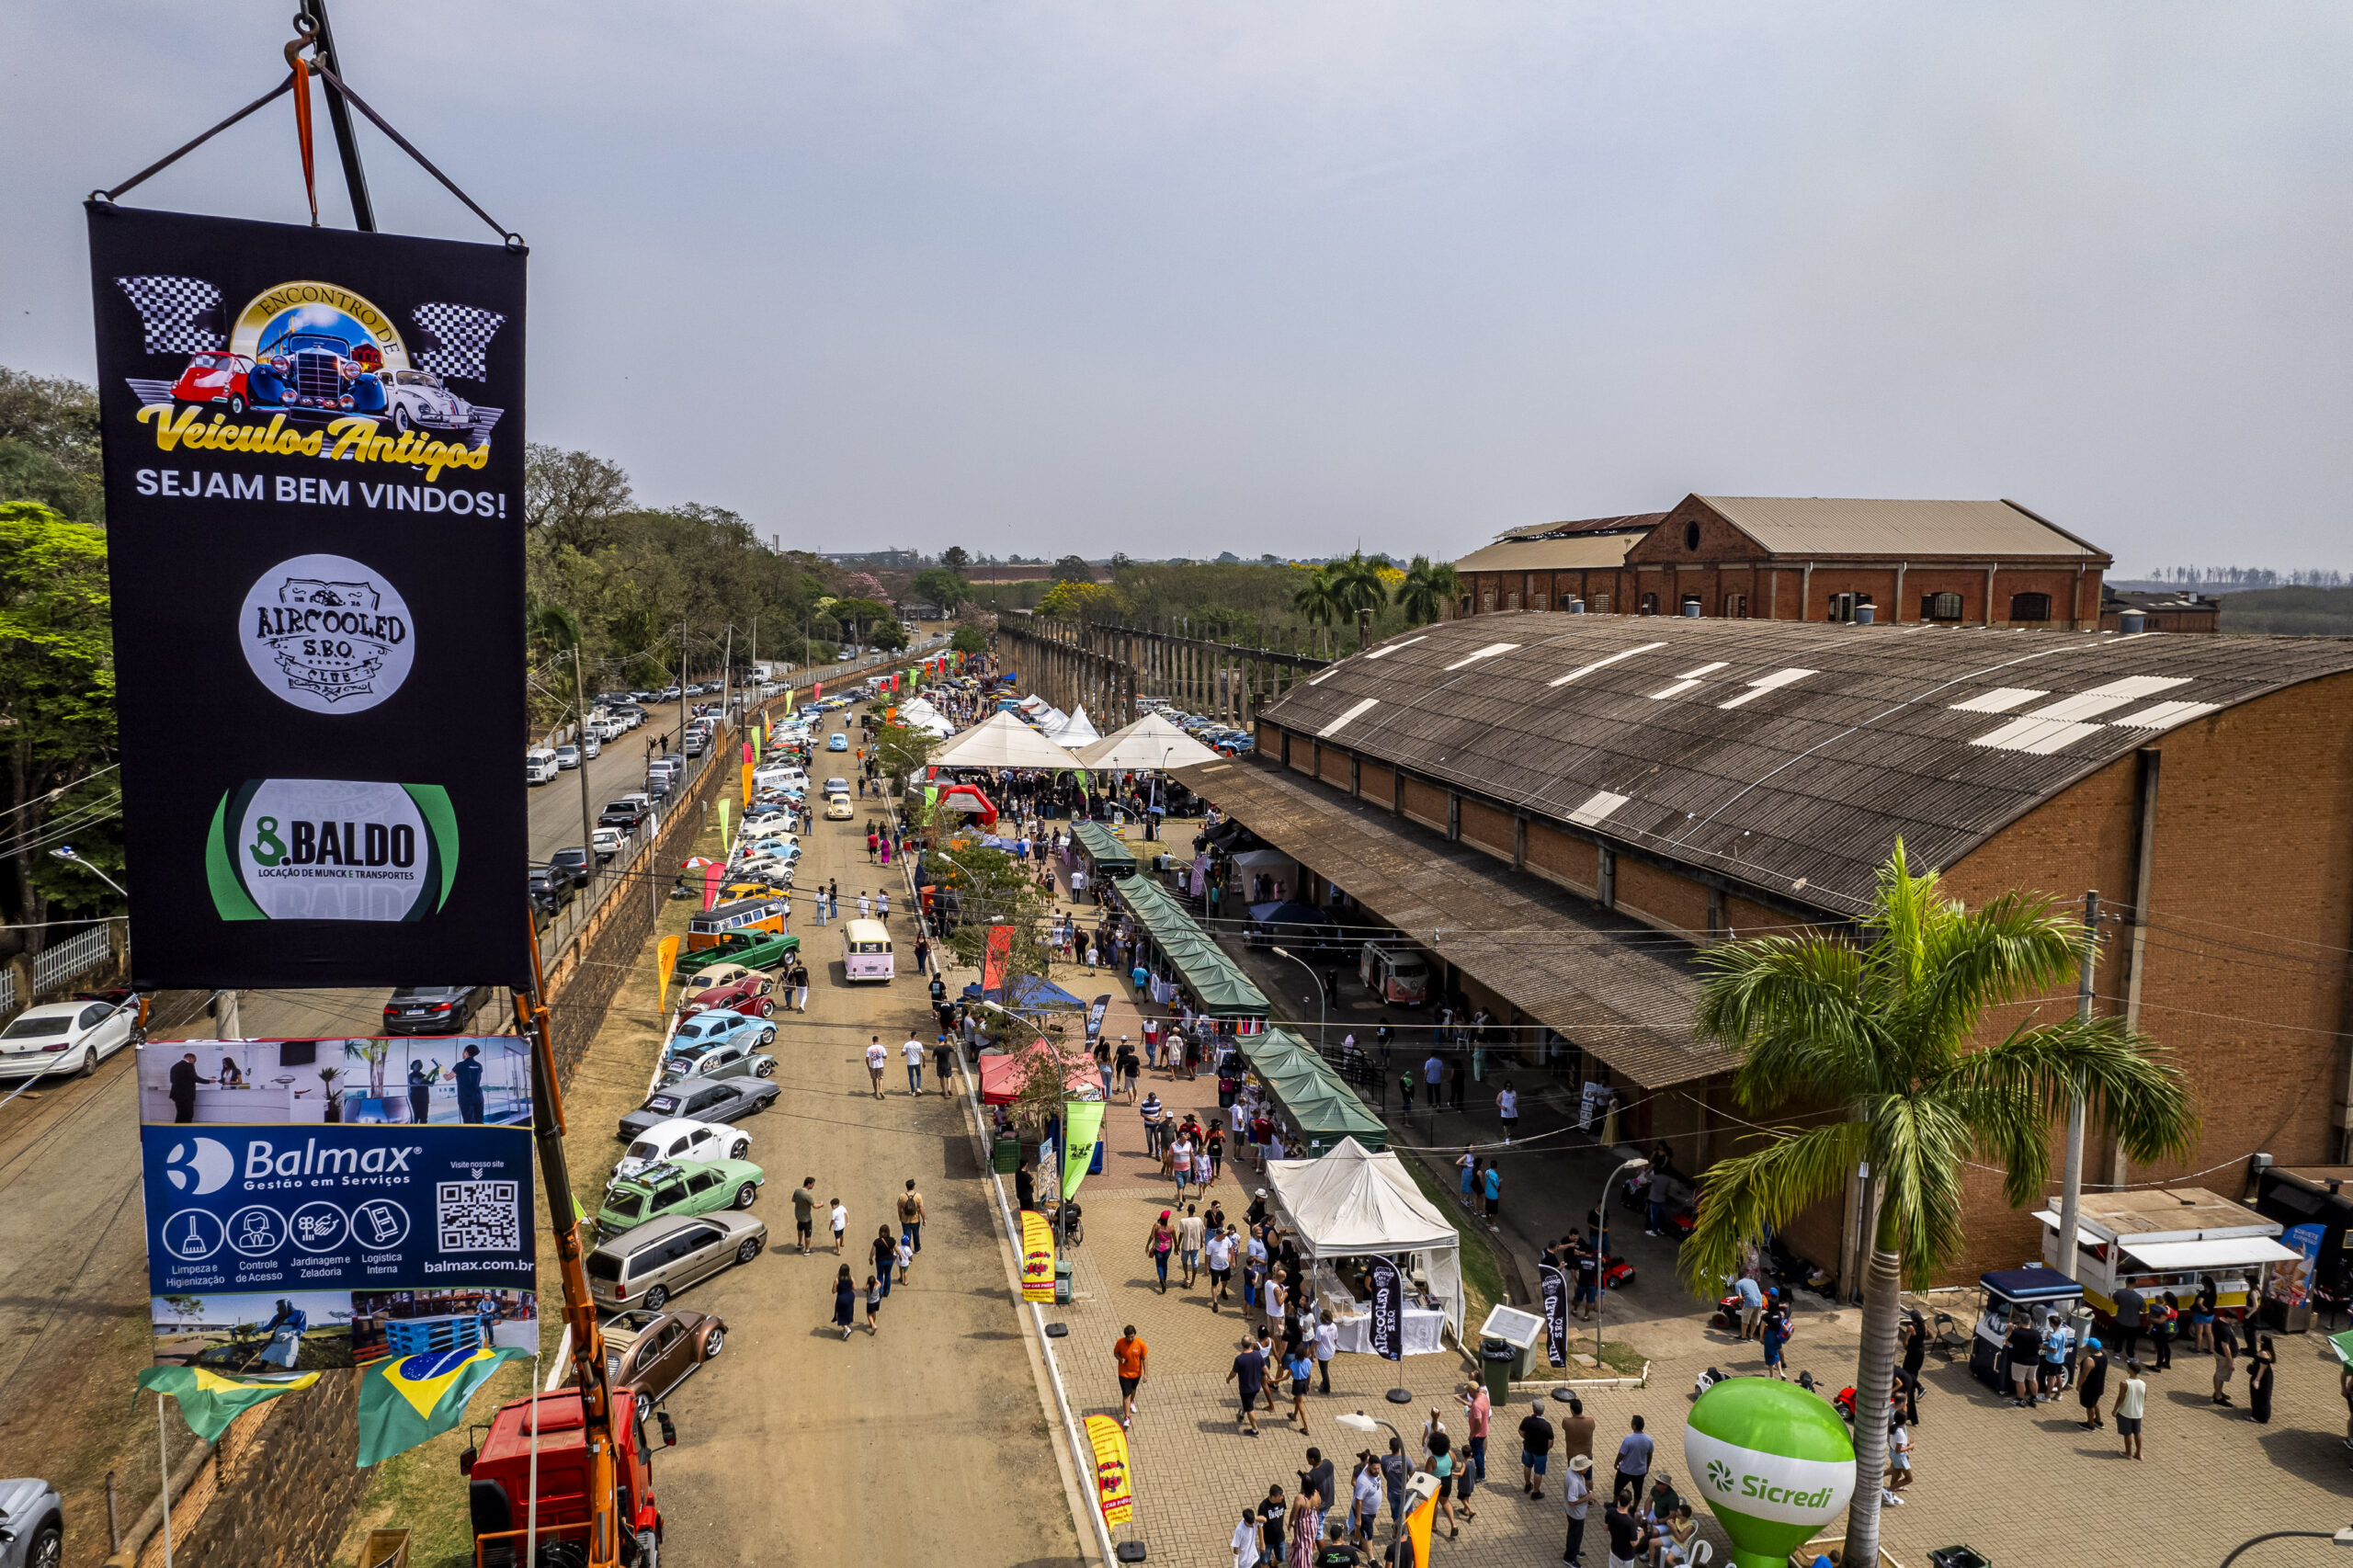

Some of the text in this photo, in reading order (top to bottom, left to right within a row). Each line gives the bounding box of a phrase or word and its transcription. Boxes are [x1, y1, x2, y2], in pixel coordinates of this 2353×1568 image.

[258, 287, 400, 355] ENCONTRO DE
[327, 416, 490, 483] Antigos
[136, 469, 506, 519] SEJAM BEM VINDOS!
[256, 607, 406, 644] AIRCOOLED
[307, 669, 351, 682] CLUB
[258, 867, 415, 880] LOCAÇÃO DE MUNCK E TRANSPORTES
[244, 1175, 410, 1190] Gestão em Serviços
[239, 1260, 278, 1270] Controle
[290, 1256, 344, 1267] Jardinagem
[361, 1253, 403, 1264] Logística
[172, 1266, 210, 1275] Limpeza
[301, 1267, 342, 1278] Zeladoria
[367, 1266, 398, 1274] Interna
[424, 1259, 535, 1273] balmax.com.br
[166, 1276, 225, 1288] Higienização
[235, 1273, 283, 1282] de Acesso
[1374, 1288, 1390, 1354] AIRCOOLED
[1741, 1474, 1834, 1508] Sicredi
